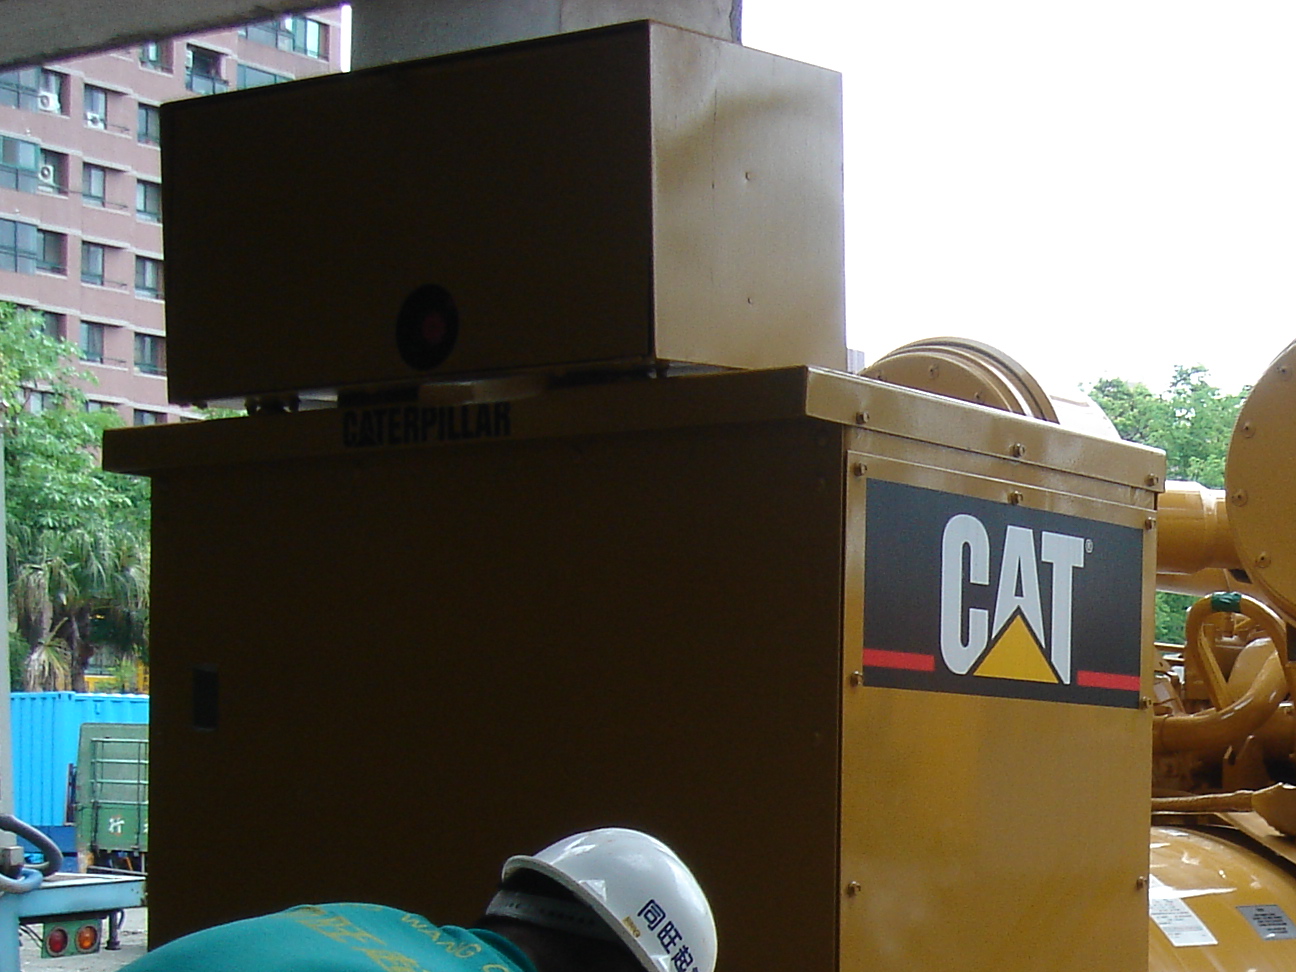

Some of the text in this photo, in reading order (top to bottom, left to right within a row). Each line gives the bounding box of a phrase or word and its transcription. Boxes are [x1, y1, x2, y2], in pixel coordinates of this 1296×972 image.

[343, 401, 511, 446] CATERPILLAR
[941, 514, 1084, 685] CAT
[400, 914, 481, 959] WANG
